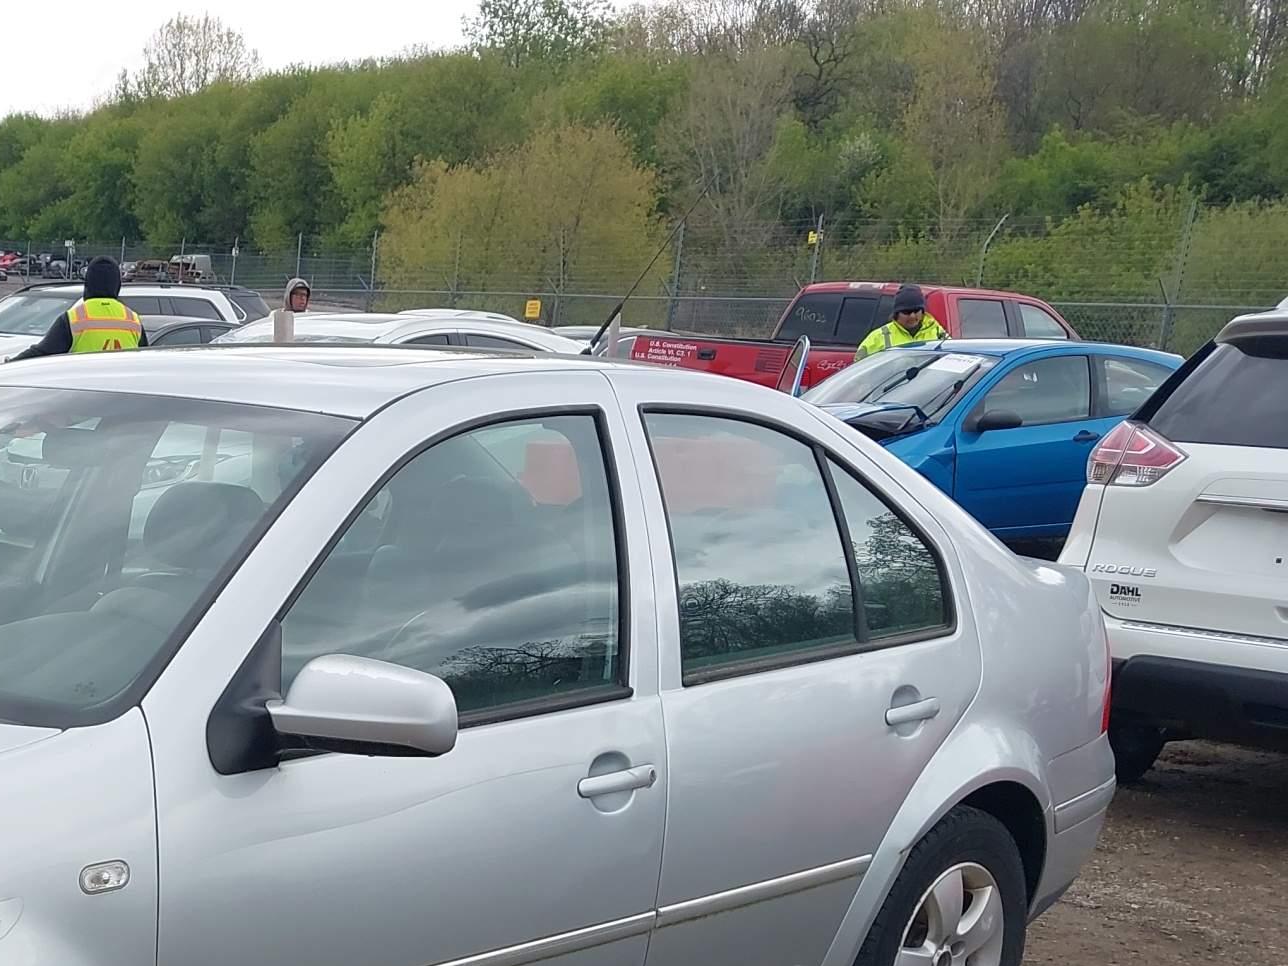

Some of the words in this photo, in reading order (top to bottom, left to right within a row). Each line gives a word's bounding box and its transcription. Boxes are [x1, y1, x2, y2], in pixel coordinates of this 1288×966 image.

[648, 347, 667, 355] Article
[662, 341, 697, 351] Constitution
[1092, 563, 1158, 578] ROGUE
[1110, 583, 1142, 597] DAHL
